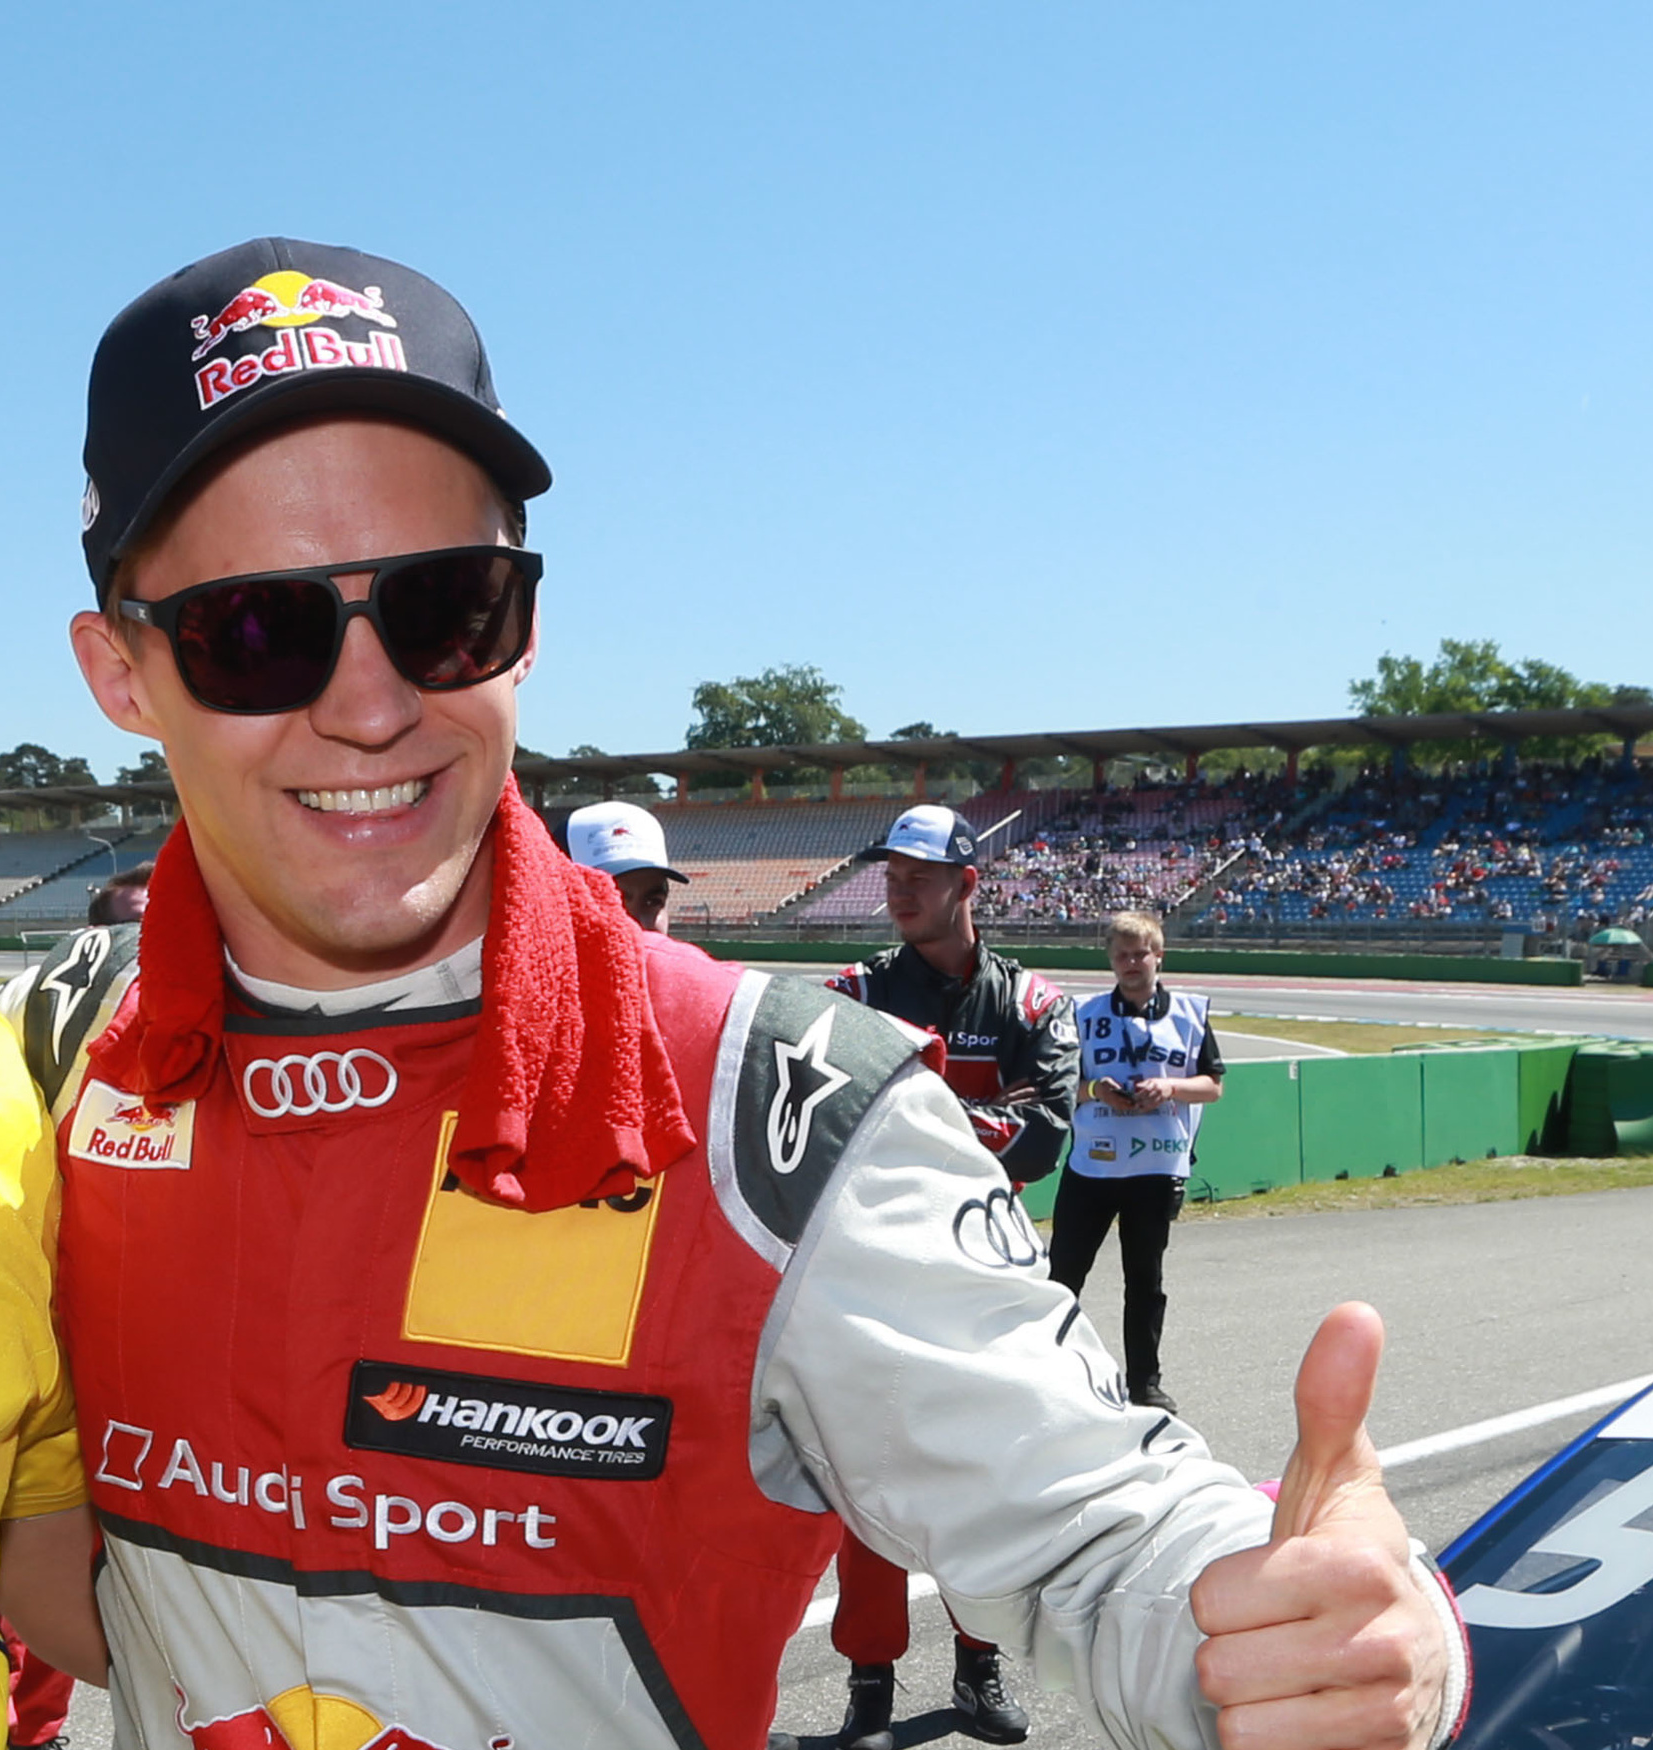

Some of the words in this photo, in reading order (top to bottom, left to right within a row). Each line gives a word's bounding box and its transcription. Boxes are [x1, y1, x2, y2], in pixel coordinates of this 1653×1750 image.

[195, 329, 303, 409] Red
[301, 327, 408, 371] Bull
[956, 1032, 999, 1048] Spor
[1083, 1016, 1111, 1041] 18
[1094, 1046, 1187, 1068] DMSB
[87, 1126, 133, 1158] Red
[132, 1132, 175, 1164] Bull
[460, 1433, 590, 1461] PERFORMANCE
[592, 1449, 646, 1465] TIRES
[157, 1438, 307, 1531] Audi
[326, 1476, 557, 1551] Sport
